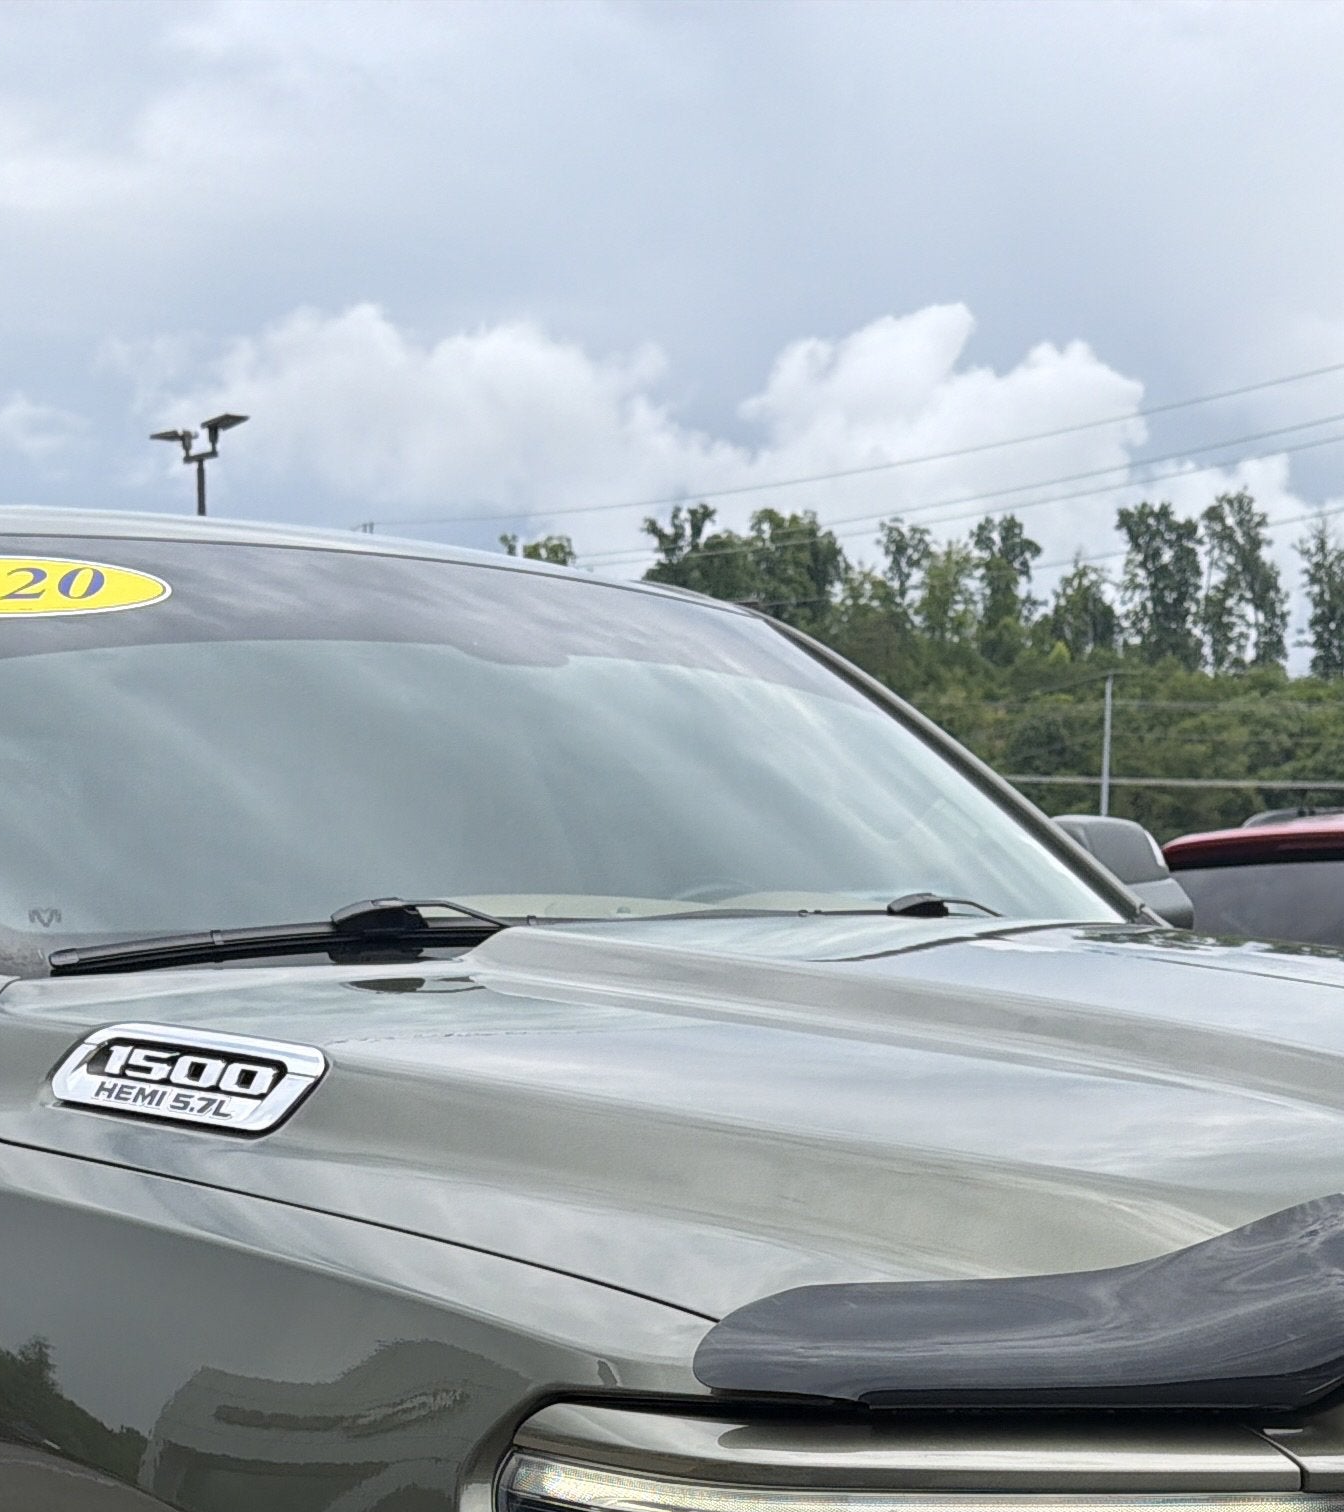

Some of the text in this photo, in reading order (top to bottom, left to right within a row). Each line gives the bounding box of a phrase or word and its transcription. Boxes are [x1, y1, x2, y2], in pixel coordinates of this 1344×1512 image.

[104, 1044, 277, 1095] 1500
[94, 1080, 233, 1119] HEMI 5.7L
